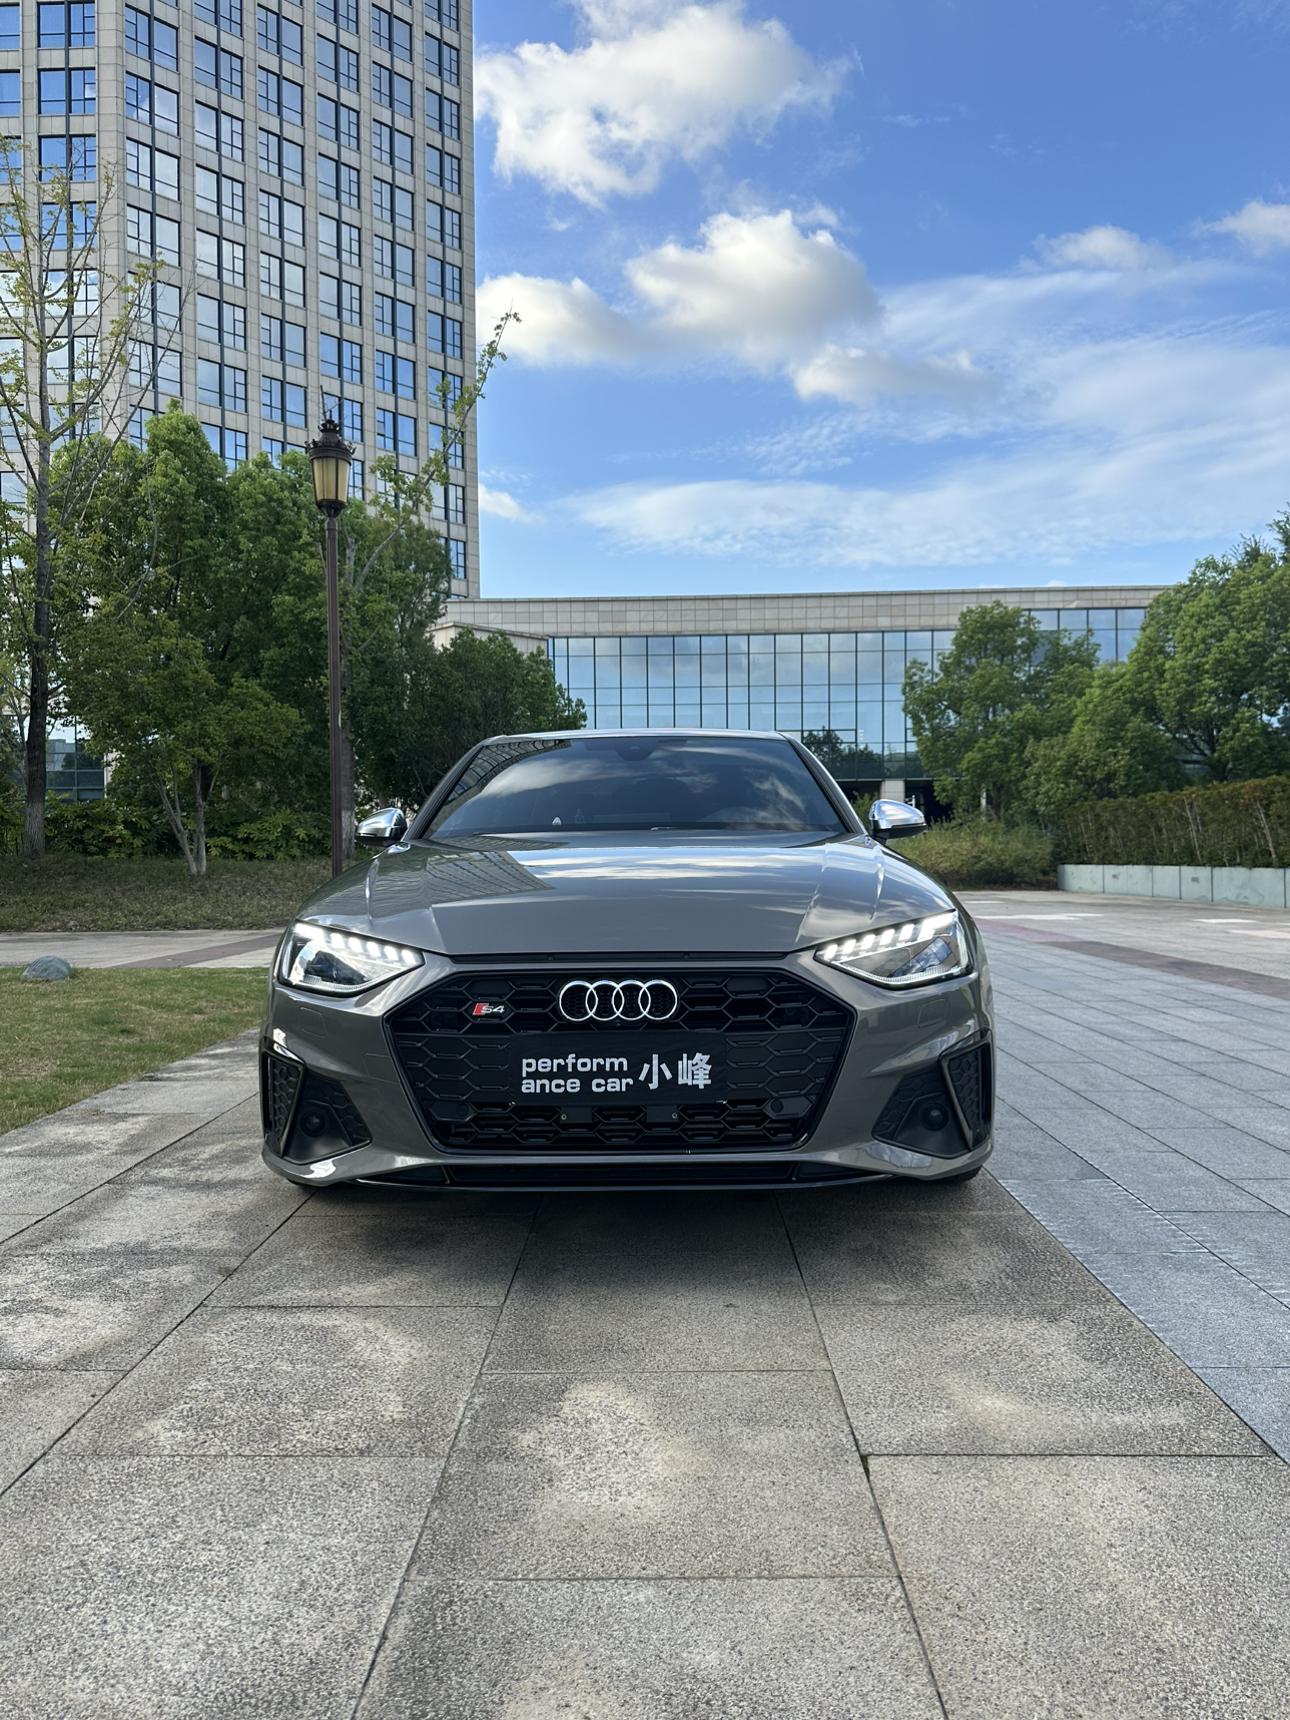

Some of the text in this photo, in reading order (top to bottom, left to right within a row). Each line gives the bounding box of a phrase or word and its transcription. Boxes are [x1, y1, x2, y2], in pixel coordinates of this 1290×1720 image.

[479, 1003, 505, 1015] S4
[521, 1053, 628, 1077] perform
[638, 1052, 713, 1090] 小峰
[521, 1077, 634, 1093] ance car
